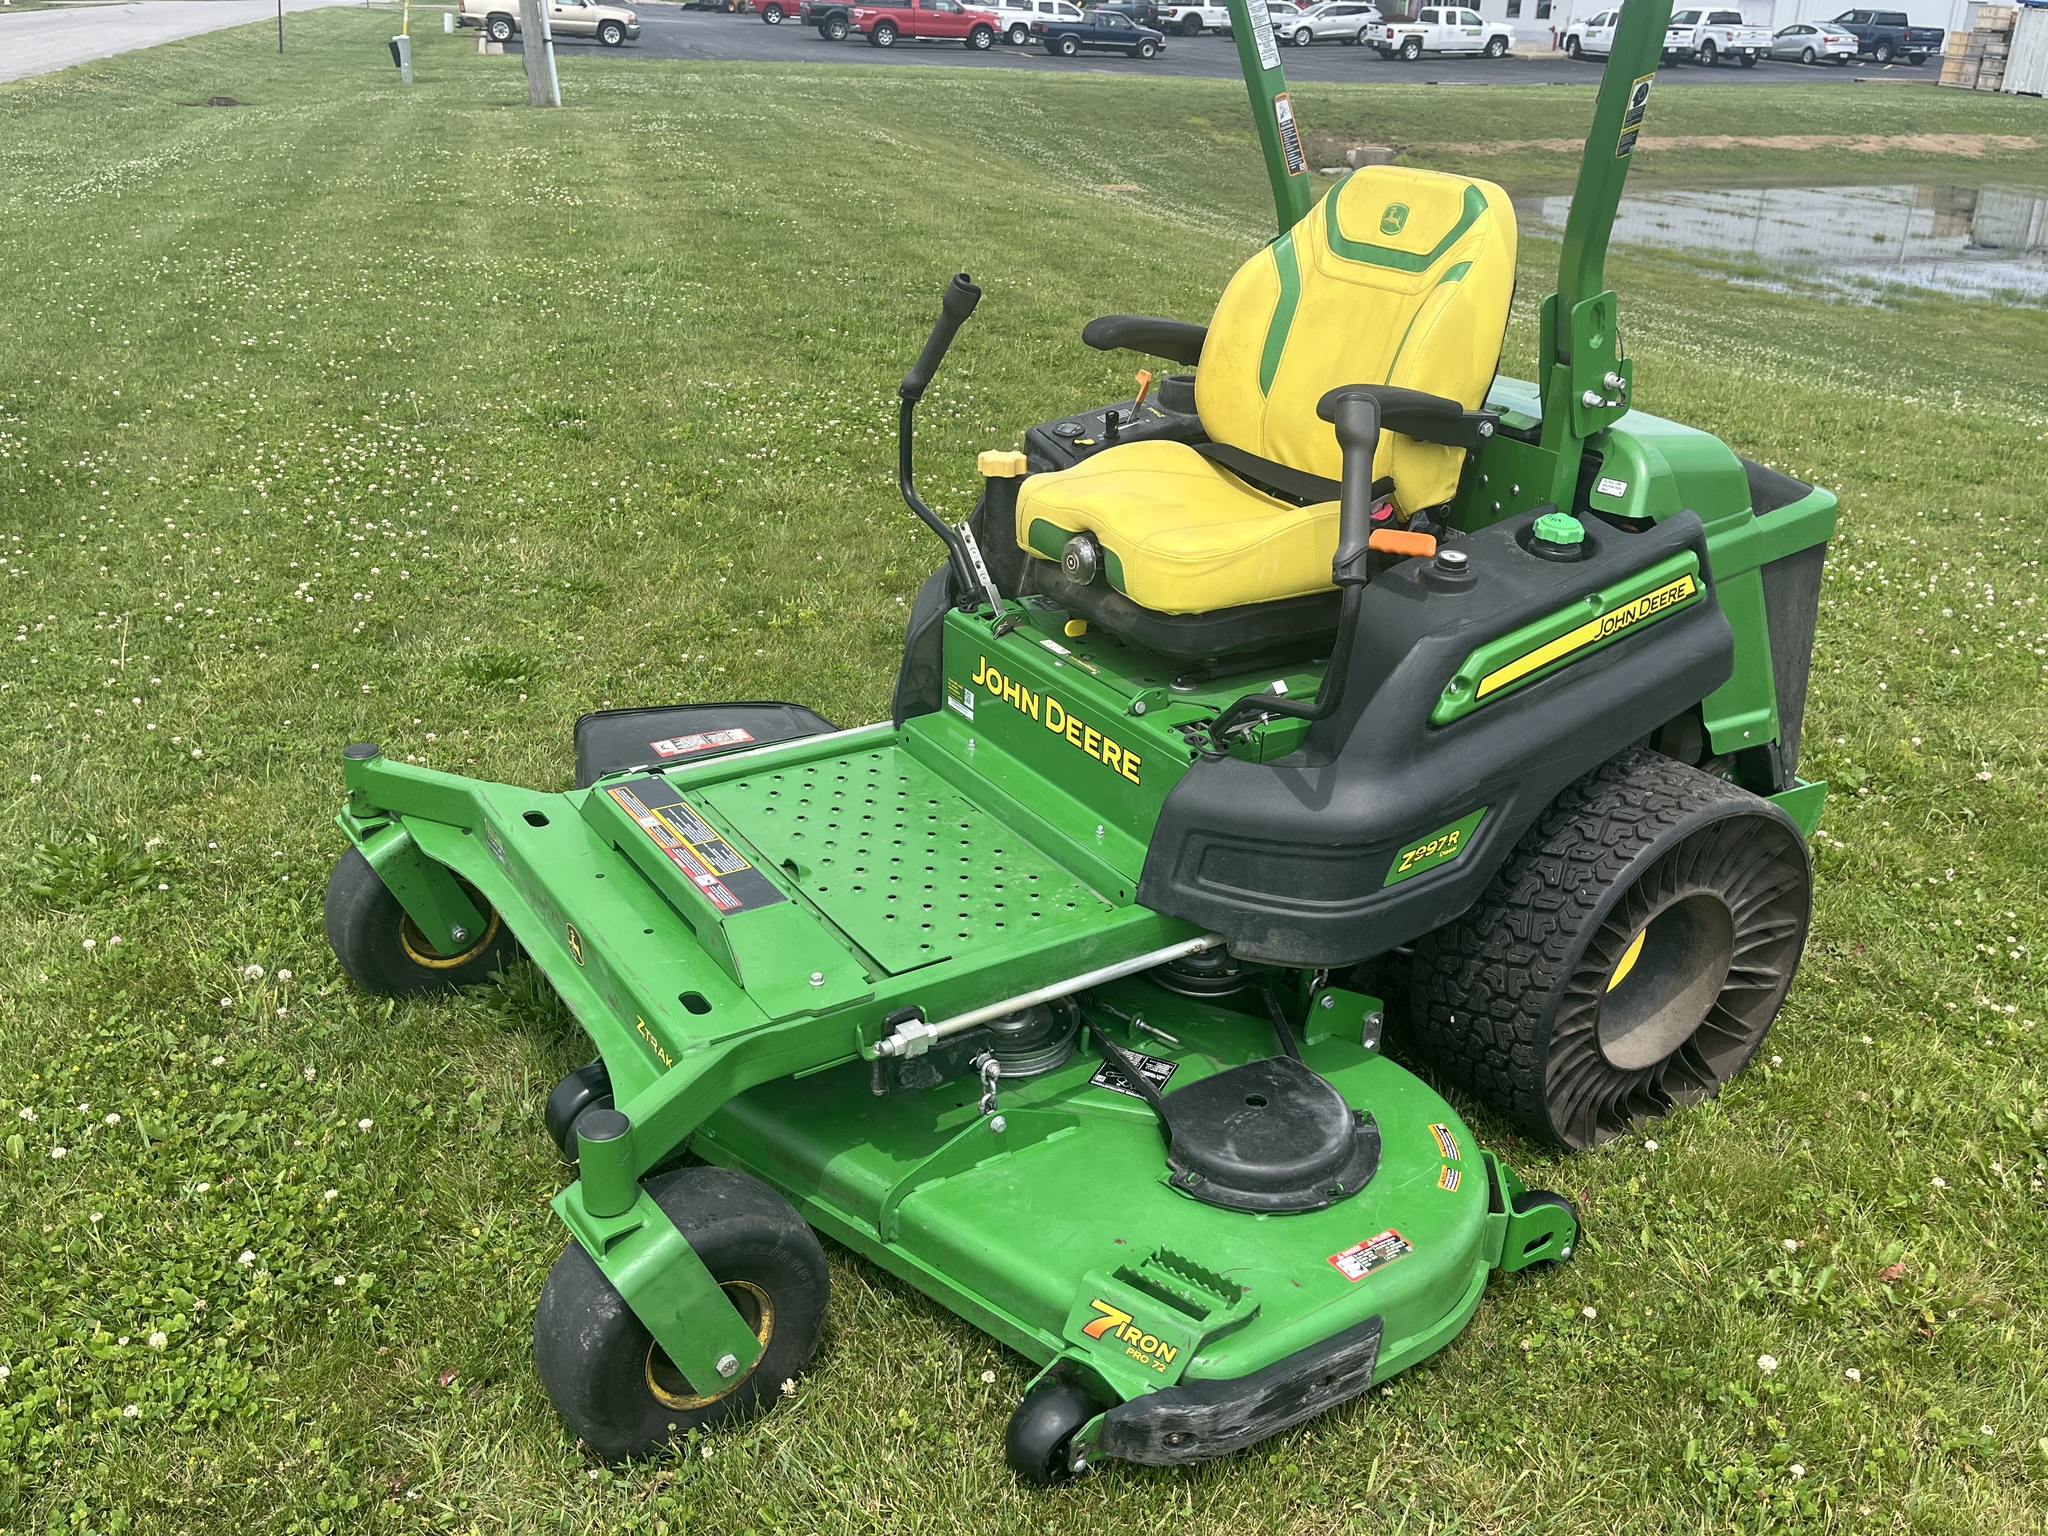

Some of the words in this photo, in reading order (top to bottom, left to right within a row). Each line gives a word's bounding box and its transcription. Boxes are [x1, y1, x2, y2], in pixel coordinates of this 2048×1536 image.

[1594, 607, 1636, 639] JOHN
[1639, 583, 1686, 617] DEERE
[971, 653, 1039, 722] JOHN
[1044, 695, 1142, 787] DEERE
[1397, 830, 1460, 873] Z997R
[636, 1014, 673, 1069] ZTRAK
[1125, 1346, 1150, 1364] PRO
[1151, 1360, 1168, 1374] 72
